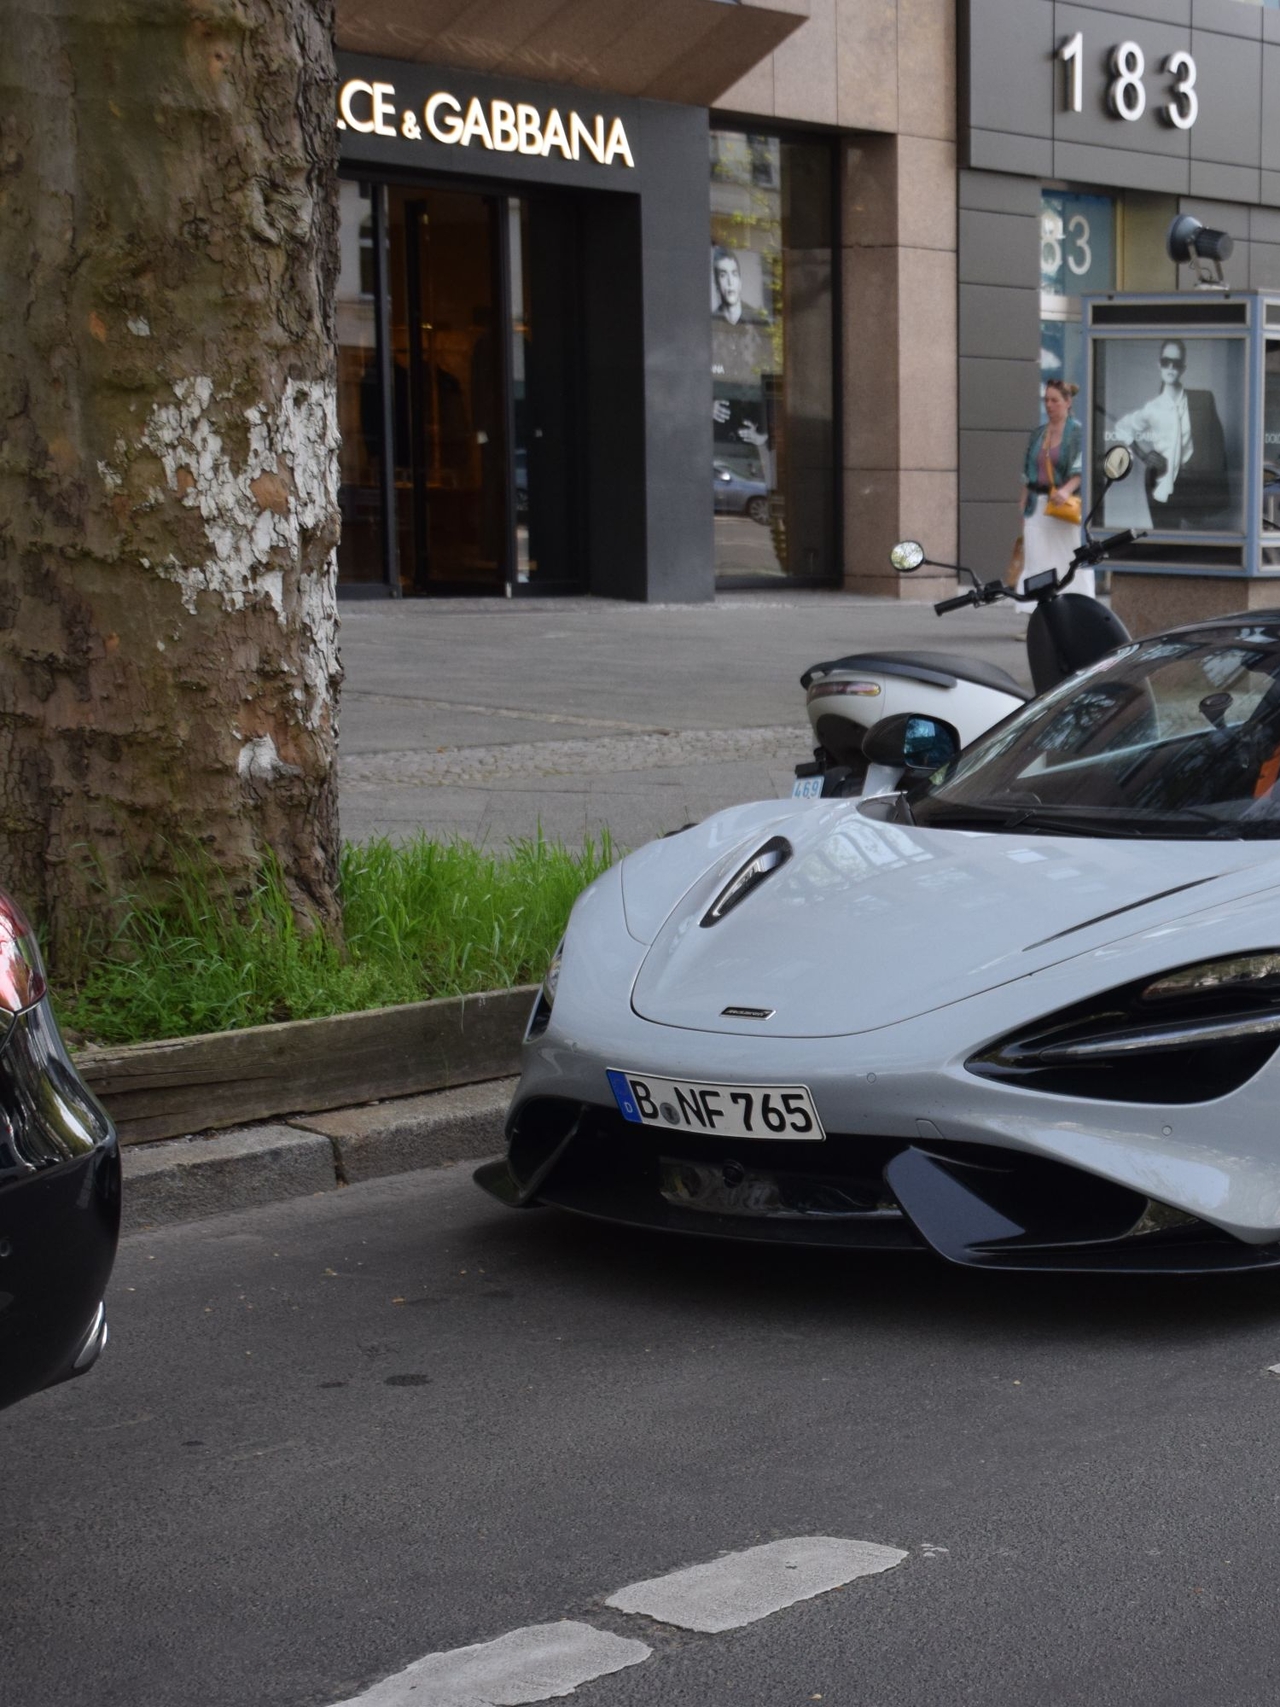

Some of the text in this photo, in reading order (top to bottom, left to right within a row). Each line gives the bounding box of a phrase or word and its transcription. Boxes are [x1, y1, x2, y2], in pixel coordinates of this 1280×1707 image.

[1060, 32, 1198, 129] 183
[337, 79, 635, 168] CE & GABBANA
[624, 1103, 633, 1114] D
[629, 1080, 813, 1133] B NF 765
